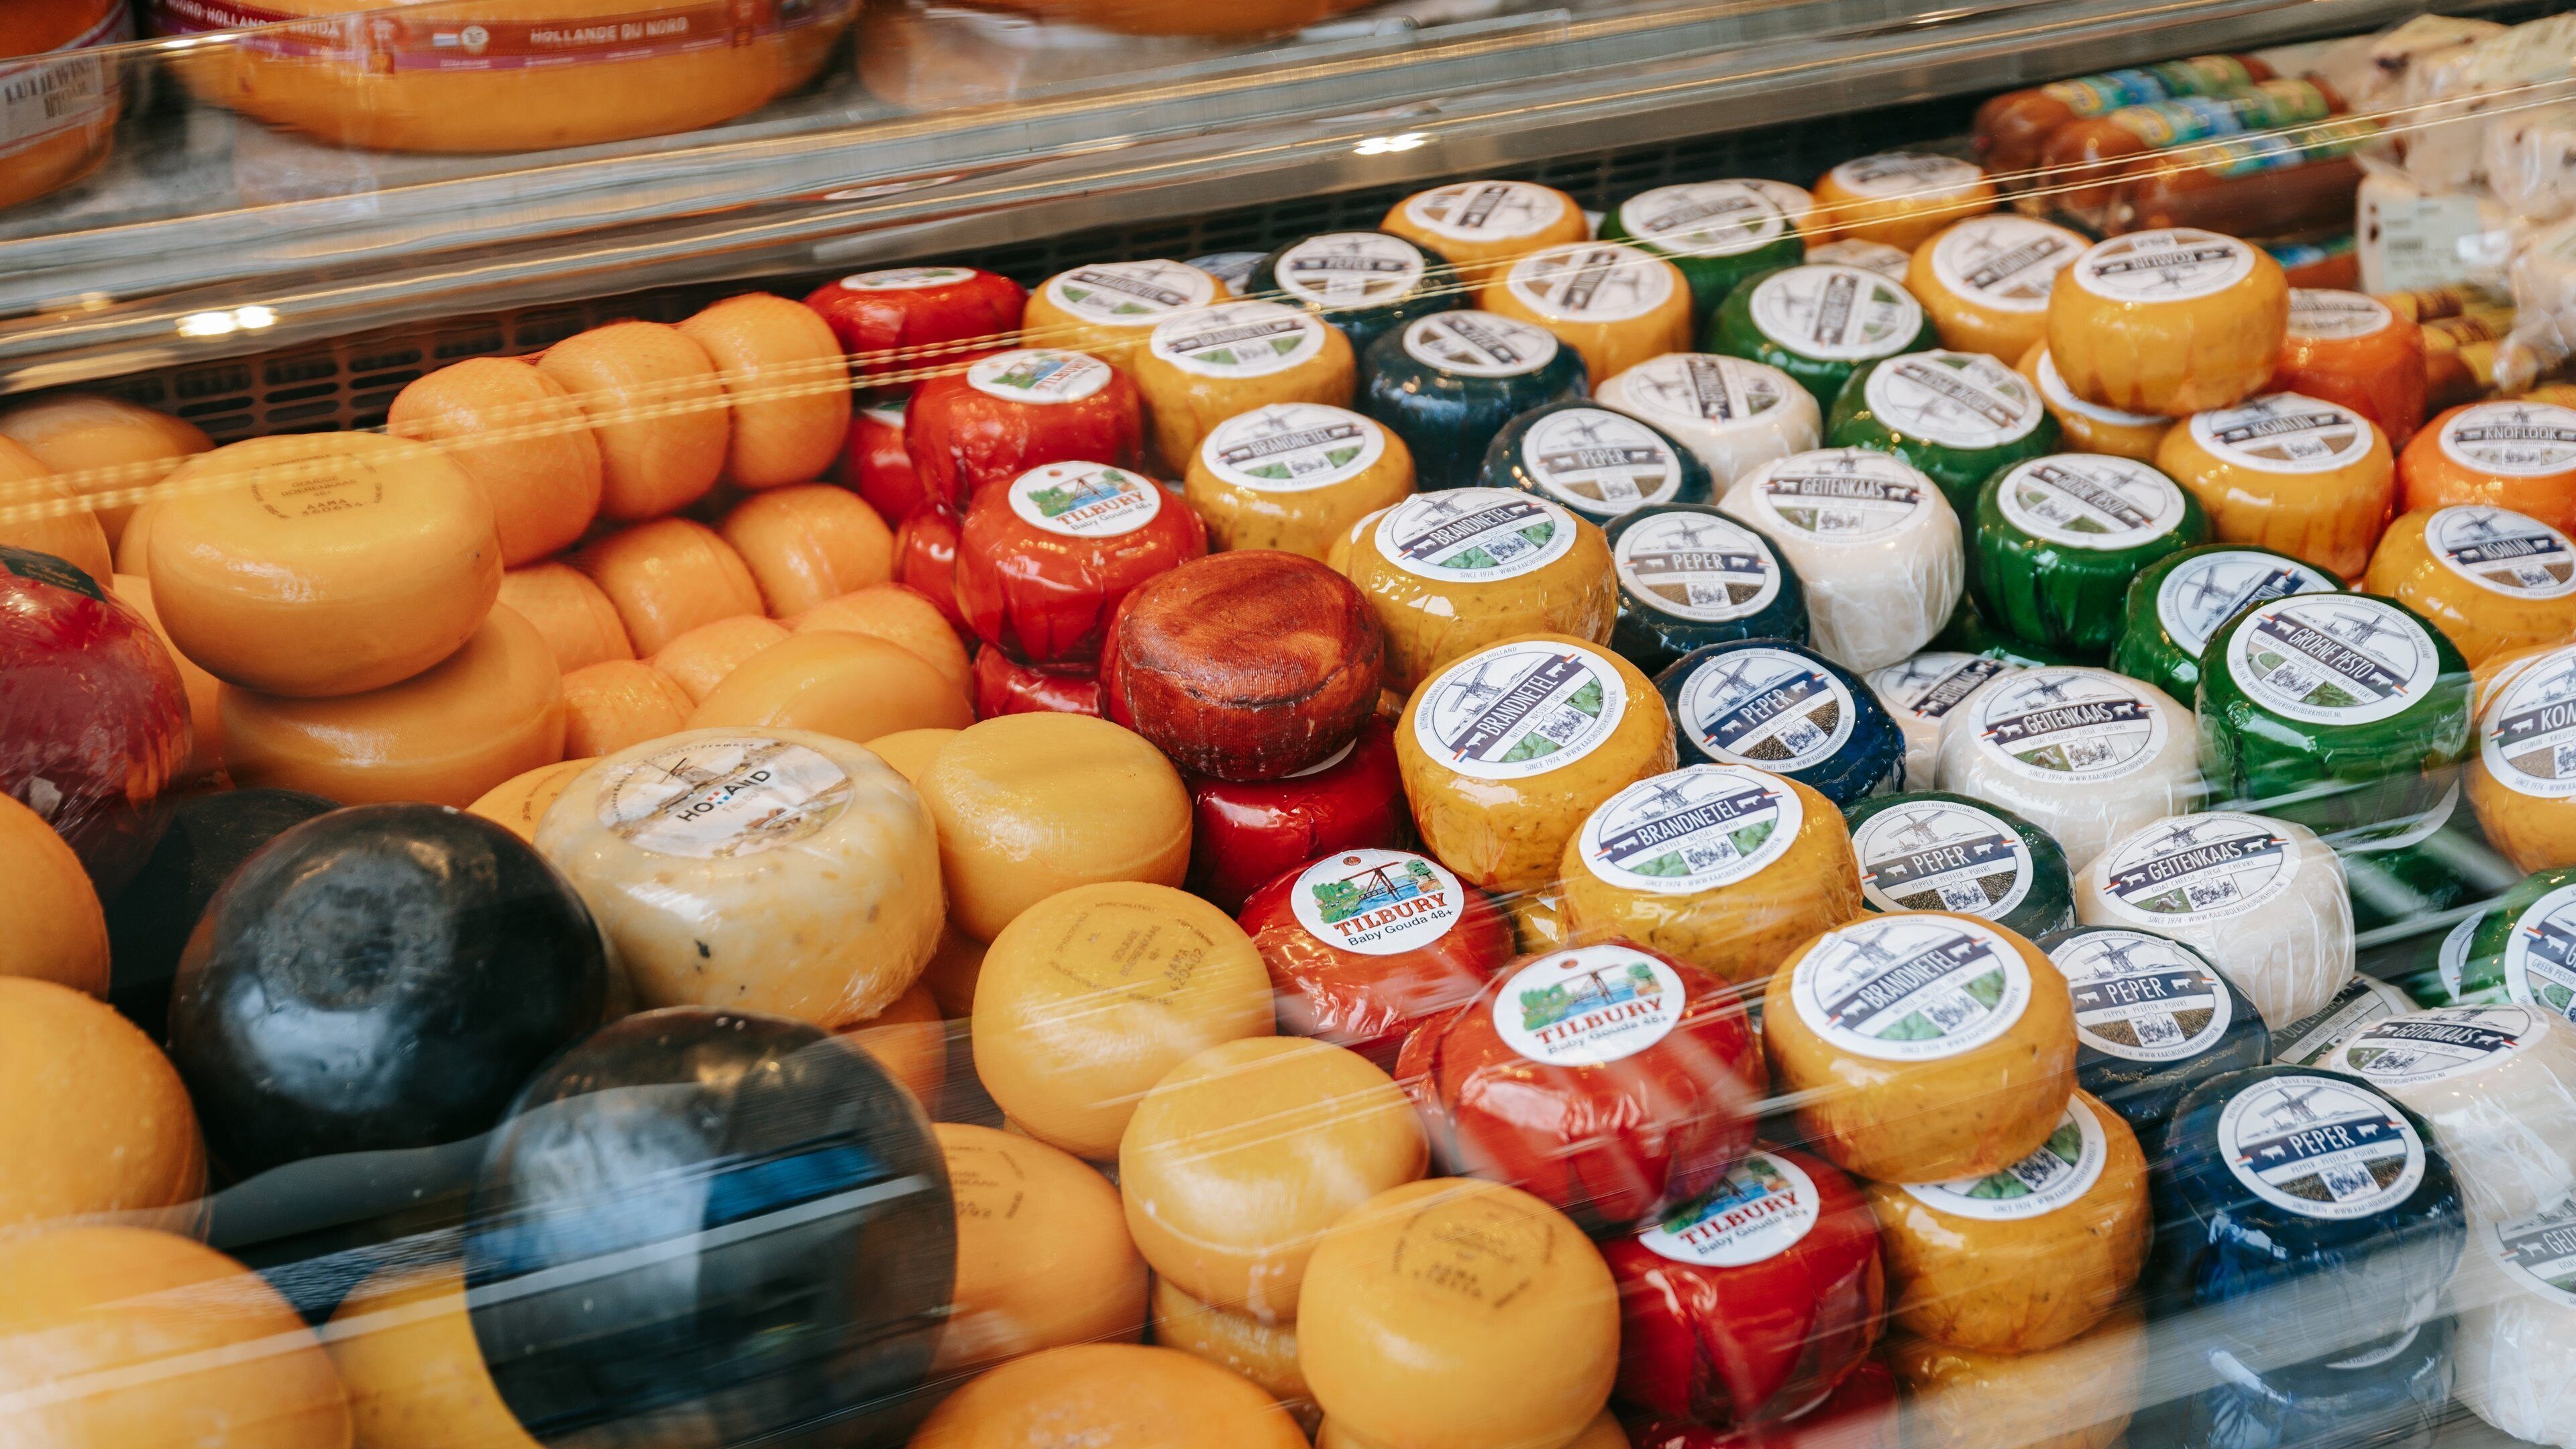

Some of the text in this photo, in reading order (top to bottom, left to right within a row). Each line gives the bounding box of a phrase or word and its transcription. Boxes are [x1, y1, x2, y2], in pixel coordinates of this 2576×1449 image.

[530, 17, 689, 45] HOLLANDE DU NORD
[2251, 415, 2316, 437] KOMIJN
[2485, 427, 2559, 440] KNOFLOOK
[1249, 427, 1334, 458] BRANDNETEL
[1577, 448, 1630, 468] PEPER
[307, 498, 347, 510] AAMA
[1055, 490, 1146, 526] TILBURY
[1069, 502, 1154, 531] Baby Gouda 48+
[1432, 506, 1517, 546] BRANDNETEL
[1455, 528, 1503, 550] NETTLE NESSEL
[1671, 553, 1725, 570] PEPER
[2479, 538, 2538, 561] KOMIJN
[1459, 570, 1495, 579] SINCE 1974
[2316, 594, 2431, 659] AUTHENTIC HANDMADE CHEESE FROM HOLLAND
[2255, 632, 2272, 645] GREEN
[2272, 641, 2291, 655] PESTO
[2318, 665, 2338, 680] PESTO
[2339, 677, 2357, 693] PESTO
[2356, 686, 2374, 700] VERT
[2288, 627, 2376, 679] GROENE PESTO
[1681, 683, 1693, 706] AUTHENTIC
[1691, 662, 1713, 684] HANDMADE
[1711, 654, 1731, 667] CHEESE
[1731, 651, 1749, 659] FROM
[2082, 670, 2113, 682] HOLLAND
[2231, 657, 2243, 672] SINCE
[2237, 668, 2247, 682] 1974
[1419, 645, 1518, 730] AUTHENTIC HANDMADE CHEESE FROM HOLLAND
[1935, 668, 1988, 705] GEITENKAAS
[1476, 674, 1559, 737] BRANDNETEL
[1509, 687, 1569, 740] NETTLE NESSEL ORTIE
[1739, 688, 1794, 726] PEPER
[2022, 702, 2113, 736] GEITENKAAS
[1750, 728, 1770, 742] PEPPER
[1771, 712, 1794, 728] PFEFFER
[2029, 736, 2047, 747] GOAT
[2048, 731, 2073, 743] CHEESE
[2078, 727, 2095, 737] ZIEGE
[2520, 737, 2543, 751] CUMIN
[1524, 761, 1544, 772] SINCE
[1544, 755, 1561, 767] 1974
[1760, 763, 1778, 771] SINCE
[1778, 761, 1792, 769] 1974
[2029, 769, 2063, 781] SINCE 1974
[2515, 777, 2544, 791] SINCE 1974
[1635, 800, 1741, 848] BRANDNETEL
[1875, 807, 1904, 823] HANDMADE
[1904, 802, 1926, 810] CHEESE
[1947, 803, 1976, 814] HOLLAND
[1911, 845, 1972, 875] PEPER
[2147, 841, 2243, 882] GEITENKAAS
[1644, 878, 1664, 887] SINCE
[1911, 865, 1992, 891] PEPPER PFEFFER POIVRE
[2151, 867, 2223, 894] GOAT CHEESE ZIEGE
[1333, 892, 1448, 937] TILBURY
[1348, 909, 1454, 947] Baby Gouda 48+
[2147, 915, 2166, 925] SINCE
[2167, 916, 2182, 925] 1974
[2125, 932, 2145, 940] FROM
[2145, 936, 2176, 947] HOLLAND
[2453, 920, 2475, 941] AUTHENTIC
[1858, 949, 1962, 1008] BRANDNETEL
[2532, 958, 2576, 985] GREEN PESTO
[2104, 976, 2168, 1005] PEPER
[1535, 994, 1664, 1045] TILBURY
[2103, 1000, 2188, 1019] PEPPER PFEFFER POIVRE
[1547, 1037, 1586, 1055] Baby
[1588, 1020, 1640, 1041] Gouda
[2298, 1015, 2346, 1053] GOAT CHEESE ZIEGE
[2395, 1022, 2475, 1045] GEITENKAAS
[2098, 1042, 2133, 1057] SINCE 1974
[2226, 1077, 2356, 1120] AUTHENTIC HANDMADE CHEESE FROM HOLLAND
[2288, 1124, 2356, 1159] PEPER
[2290, 1162, 2316, 1175] PEPPER
[1678, 1189, 1800, 1246] TILBURY
[1695, 1234, 1734, 1256] Baby
[1735, 1216, 1782, 1237] Gouda
